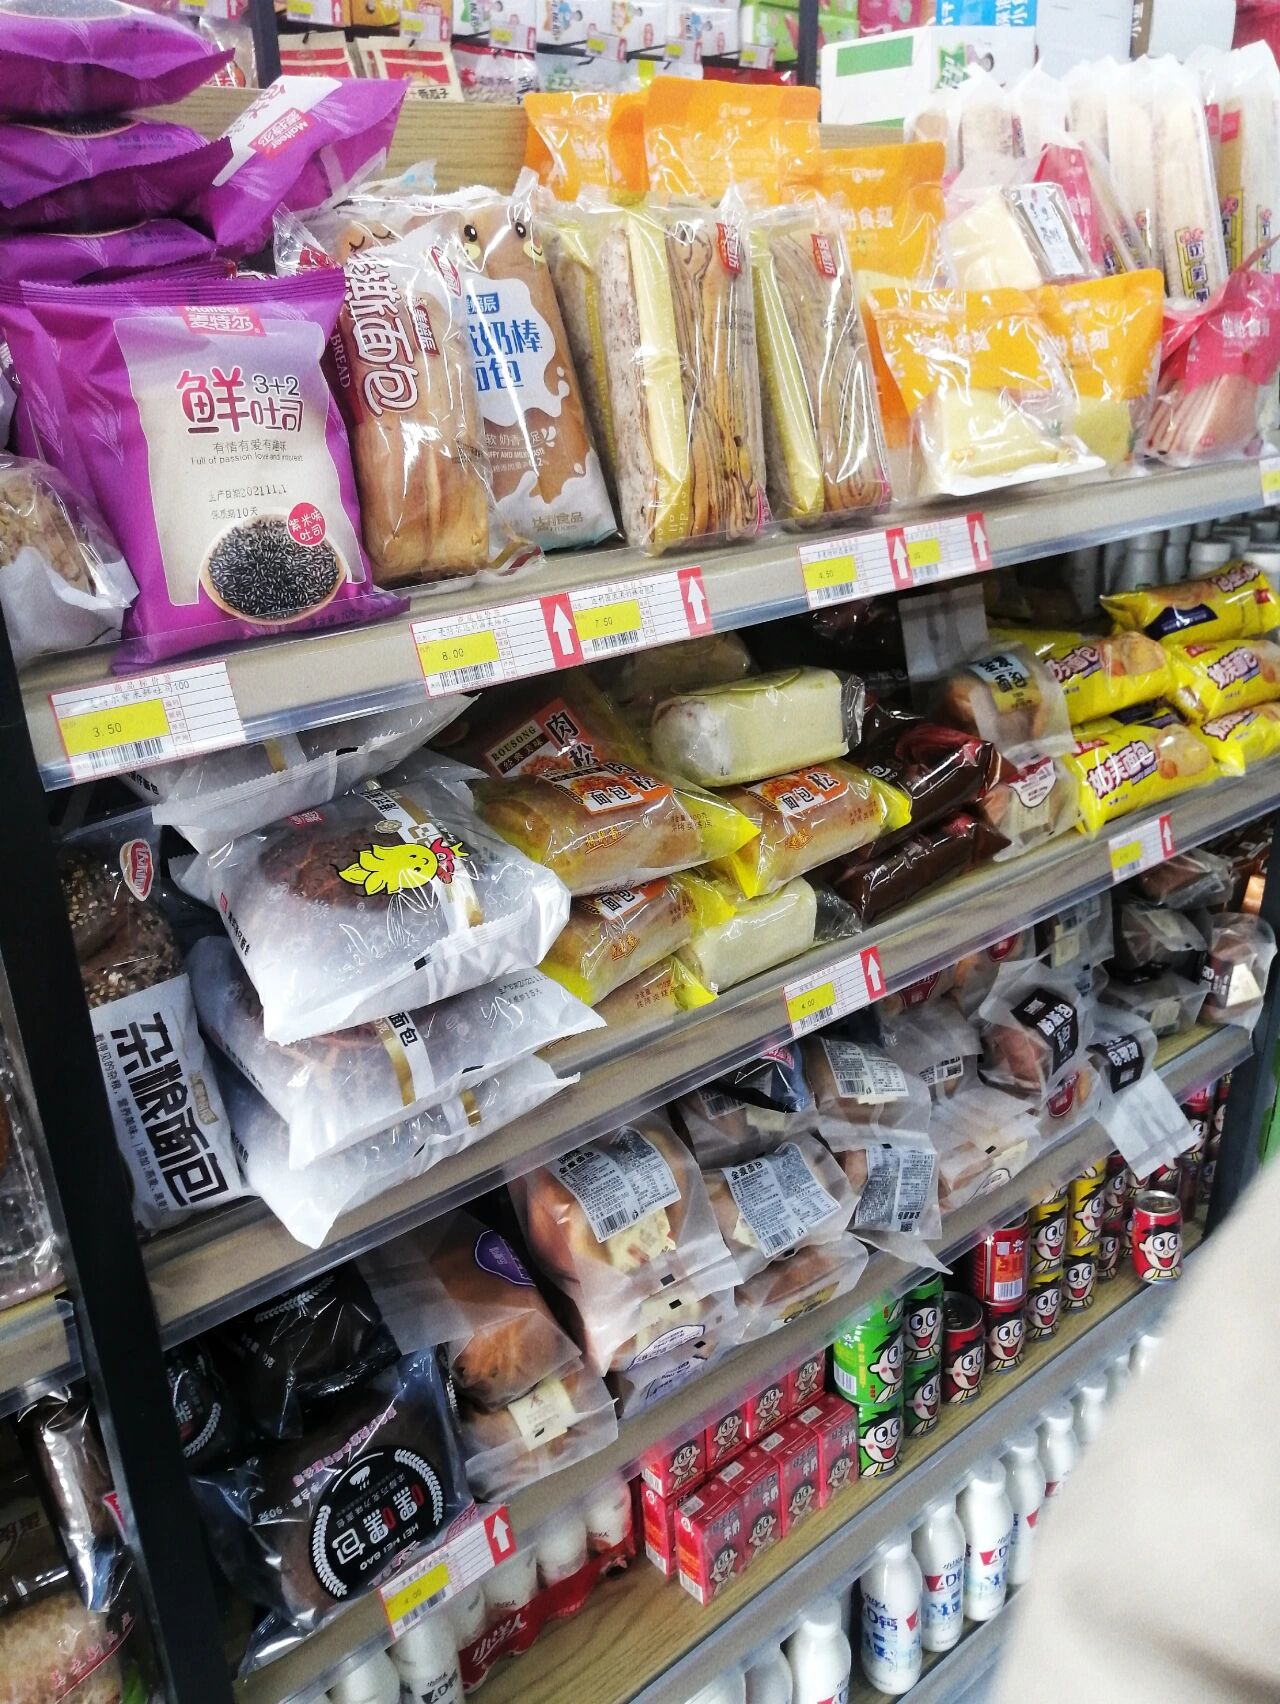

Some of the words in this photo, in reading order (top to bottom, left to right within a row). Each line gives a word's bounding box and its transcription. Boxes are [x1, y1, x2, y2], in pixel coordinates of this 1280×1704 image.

[188, 313, 254, 332] 麦特尔
[330, 332, 351, 389] BREAD
[252, 375, 301, 396] 3+2
[176, 366, 250, 434] 鲜
[249, 396, 304, 433] 吐司
[219, 450, 253, 463] passion
[299, 524, 323, 542] 吐司
[491, 725, 537, 762] ROUSONG
[589, 785, 631, 806] 面包
[780, 786, 814, 810] 面包
[109, 1011, 230, 1208] 杂粮面包
